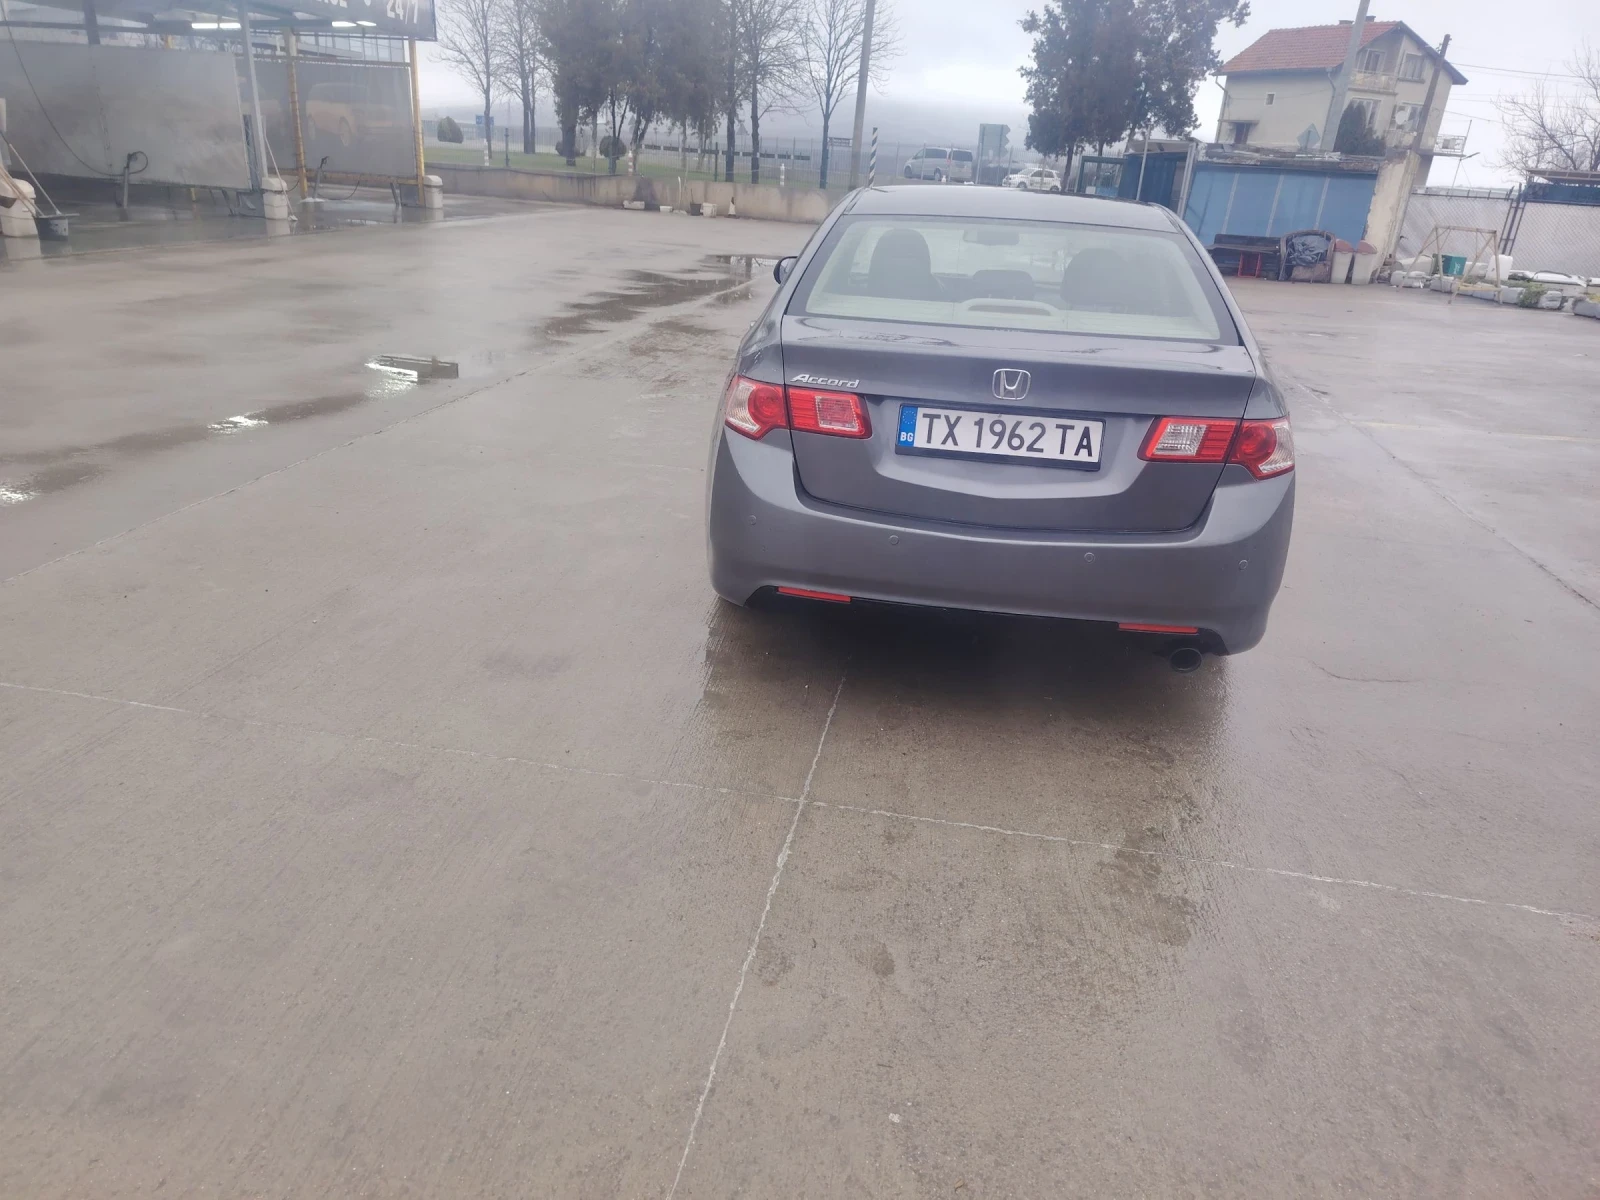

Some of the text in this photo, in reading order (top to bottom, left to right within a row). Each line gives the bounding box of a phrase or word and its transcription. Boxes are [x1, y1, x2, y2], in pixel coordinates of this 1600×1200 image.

[790, 373, 860, 389] Accord
[900, 431, 914, 442] BG
[922, 413, 1093, 457] TX 1962 TA
